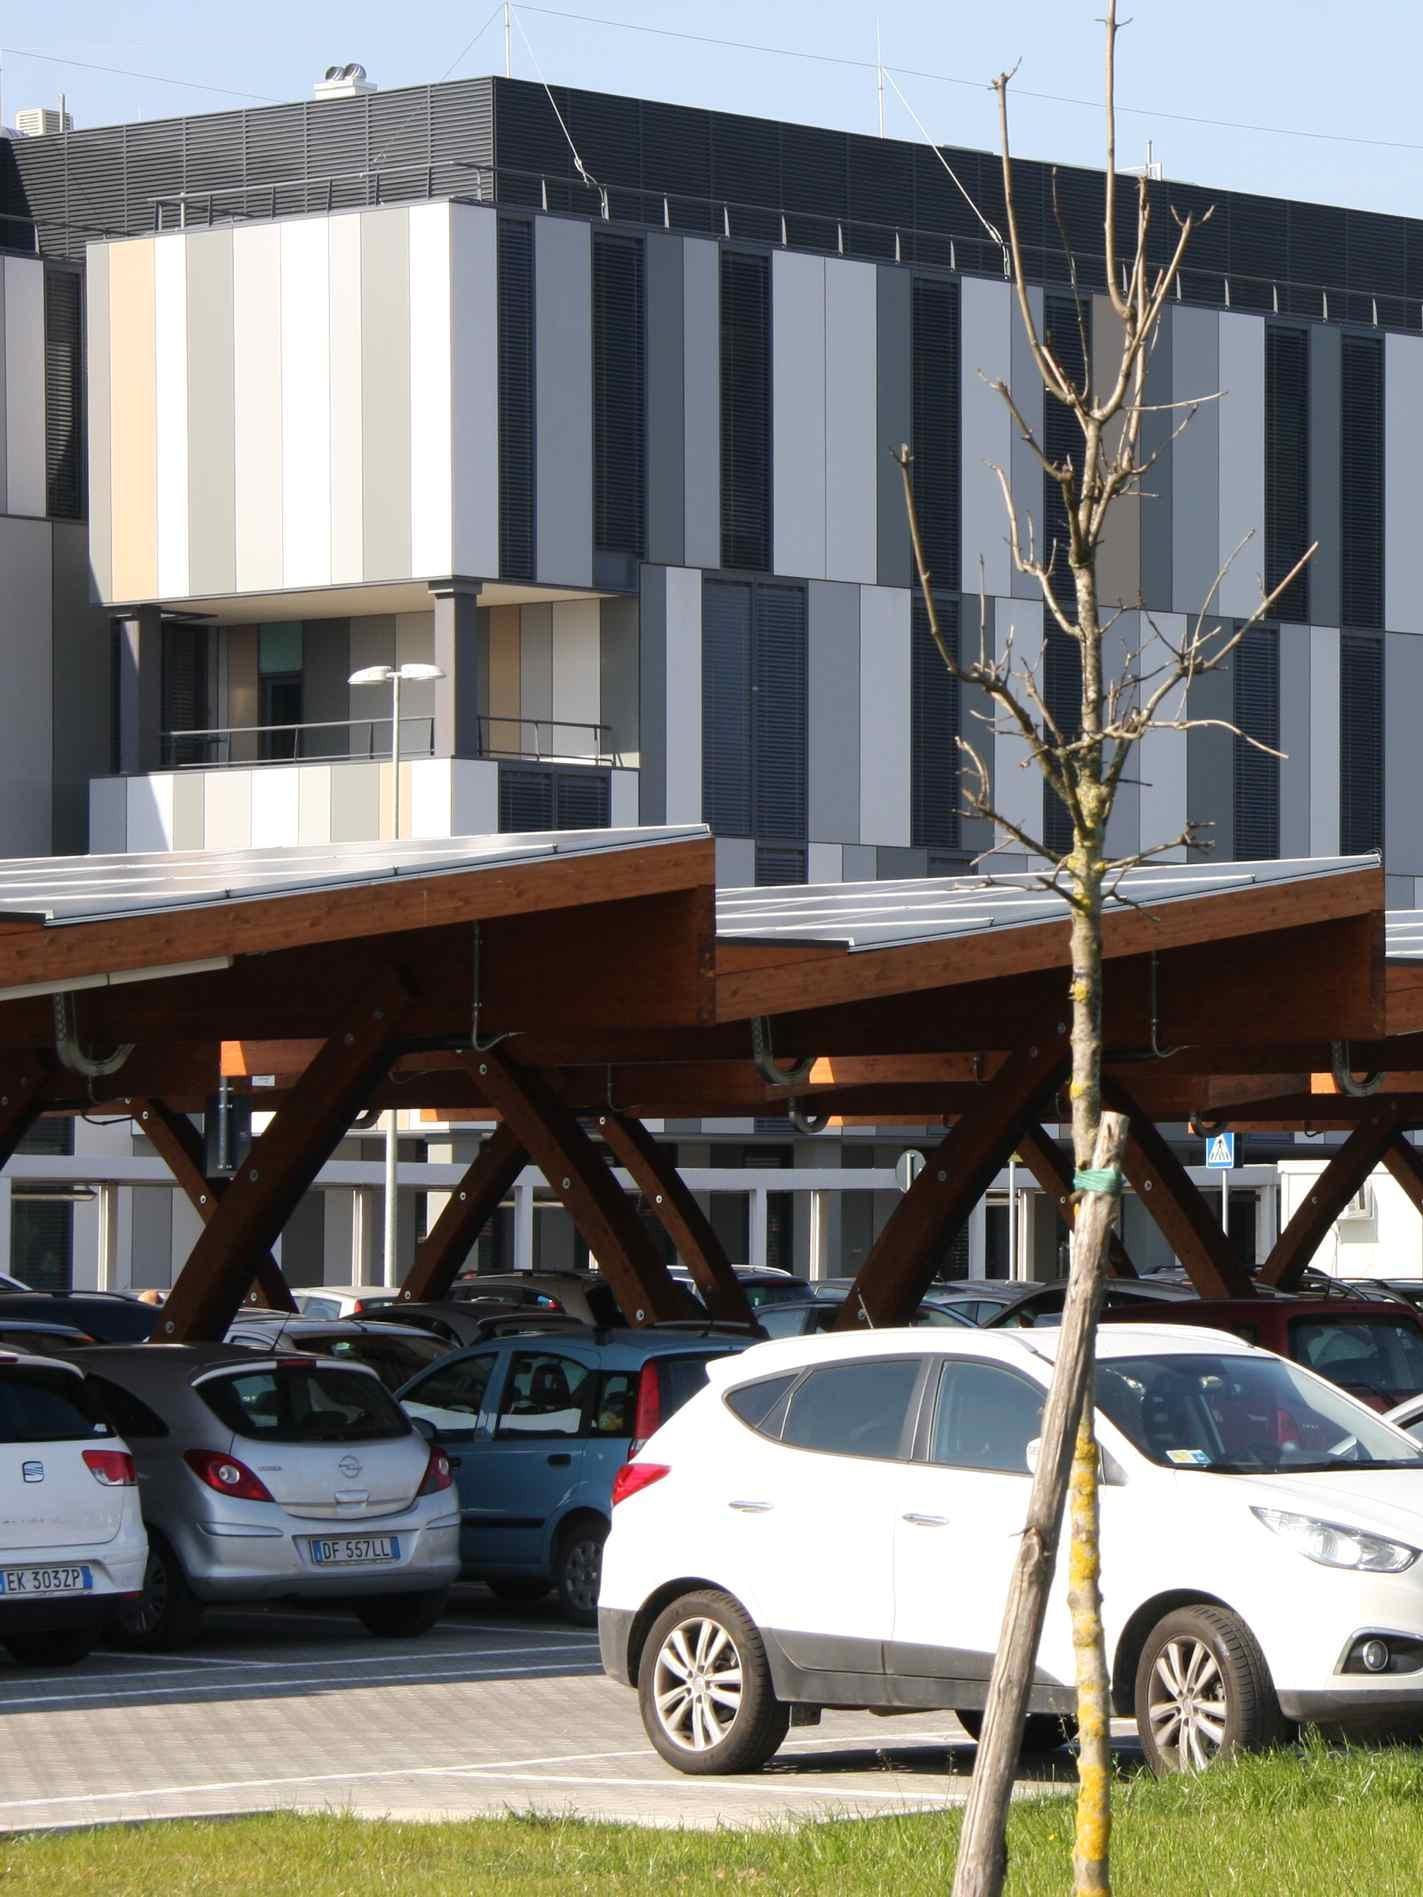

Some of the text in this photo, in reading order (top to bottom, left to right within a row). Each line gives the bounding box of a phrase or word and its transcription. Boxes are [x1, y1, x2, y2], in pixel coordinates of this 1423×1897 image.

[322, 1539, 390, 1560] DF 557LL
[6, 1568, 80, 1591] EK 303ZP
